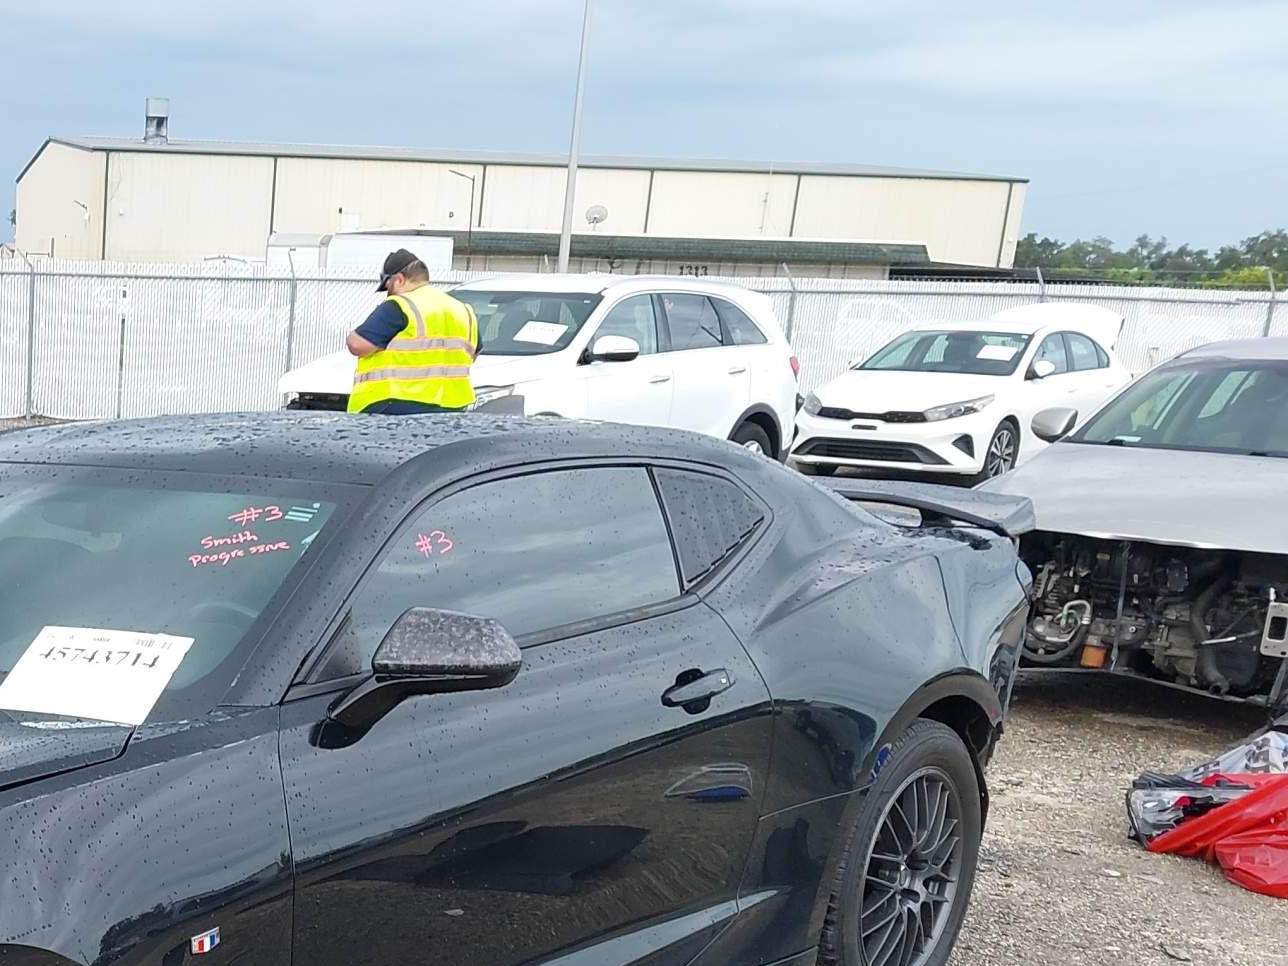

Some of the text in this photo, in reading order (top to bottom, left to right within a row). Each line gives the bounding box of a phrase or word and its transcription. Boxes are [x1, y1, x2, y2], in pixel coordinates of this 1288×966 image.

[200, 530, 258, 549] Smith
[415, 529, 454, 559] #3
[39, 646, 161, 669] 45743714
